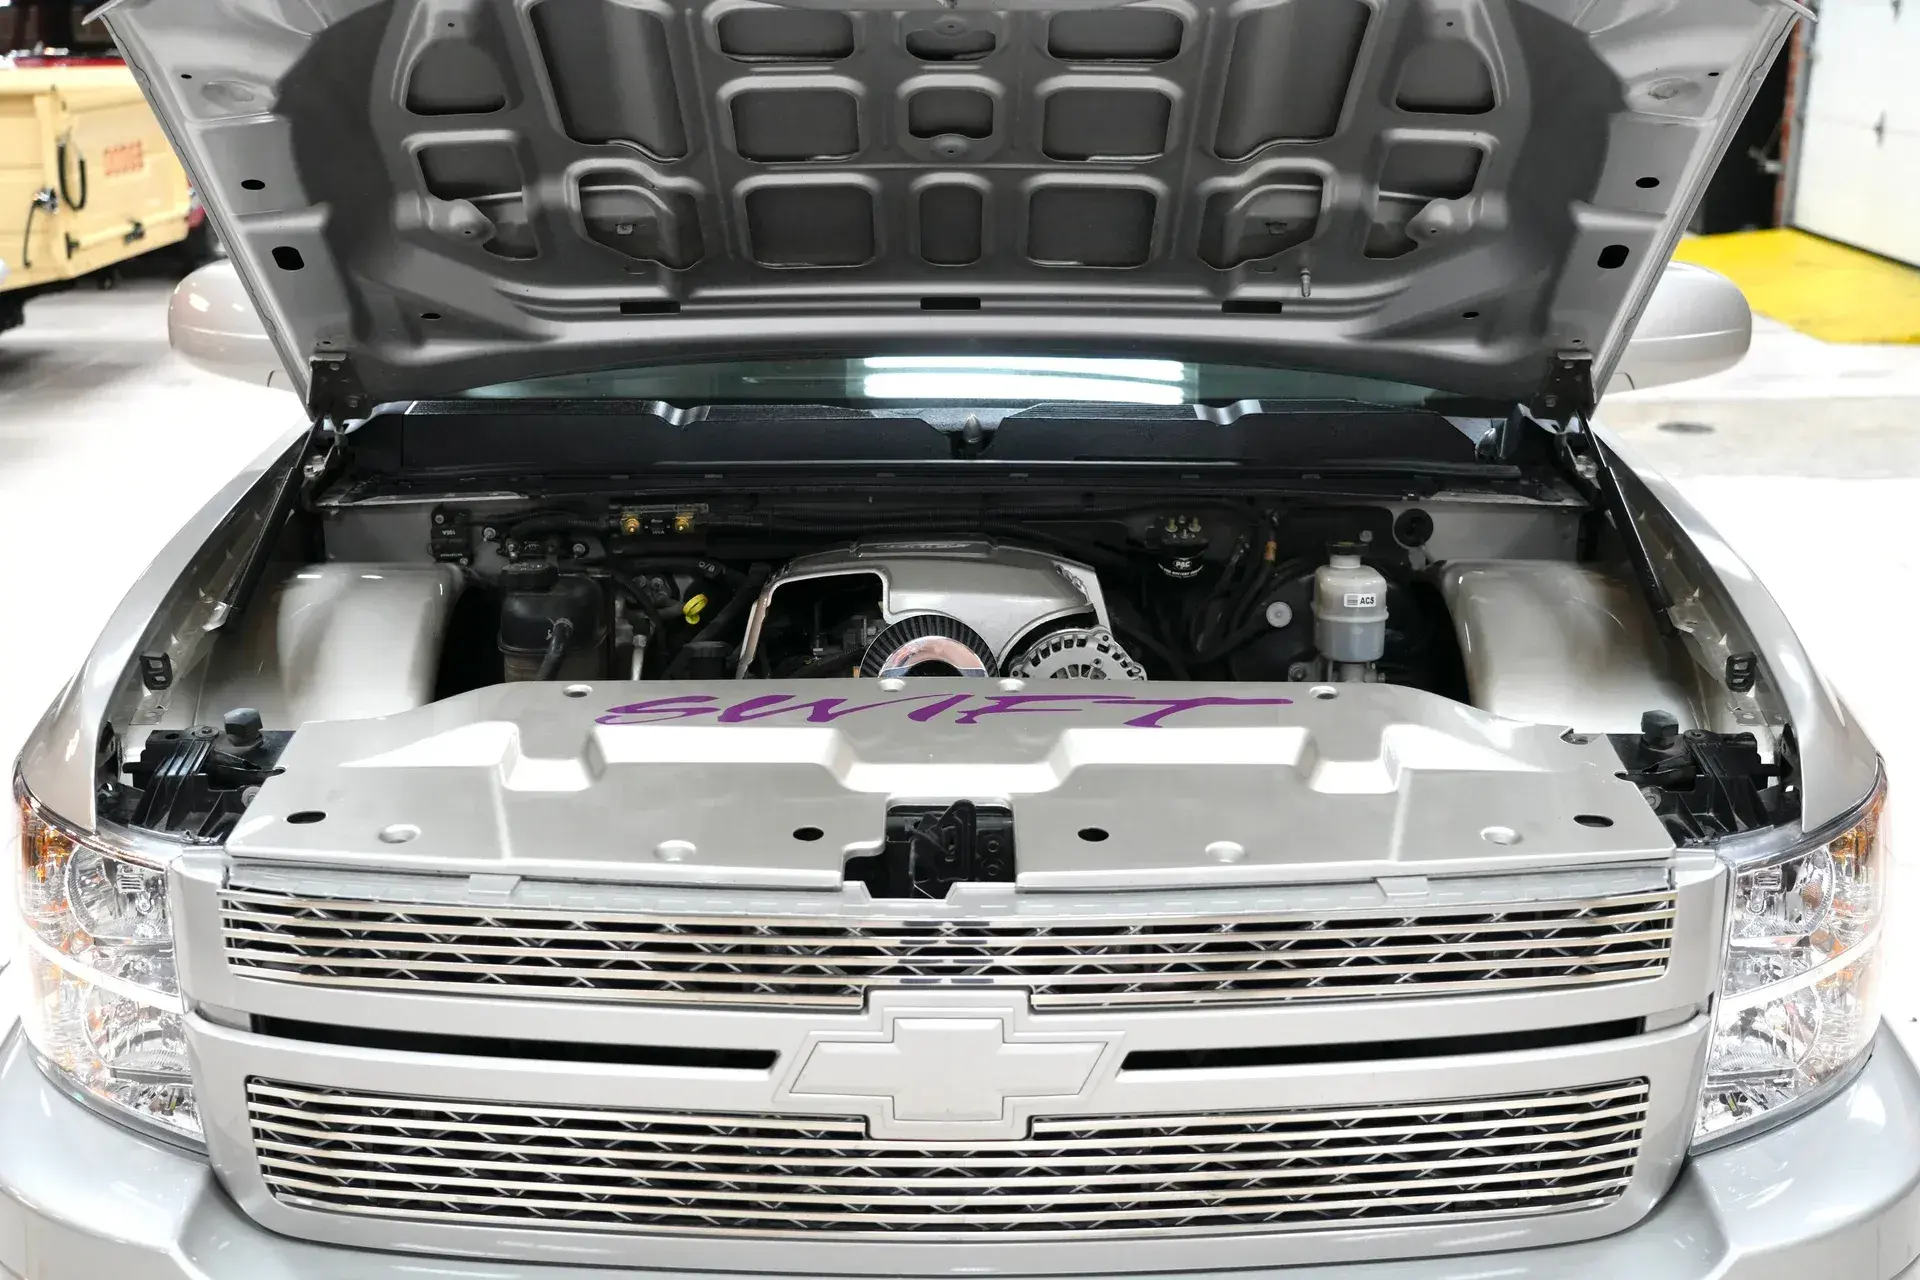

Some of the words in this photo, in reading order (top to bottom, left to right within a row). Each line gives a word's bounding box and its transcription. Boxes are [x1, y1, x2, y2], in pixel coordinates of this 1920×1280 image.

[1175, 560, 1191, 568] PAC
[1360, 596, 1375, 605] ACS
[595, 693, 1292, 728] SWIFT
